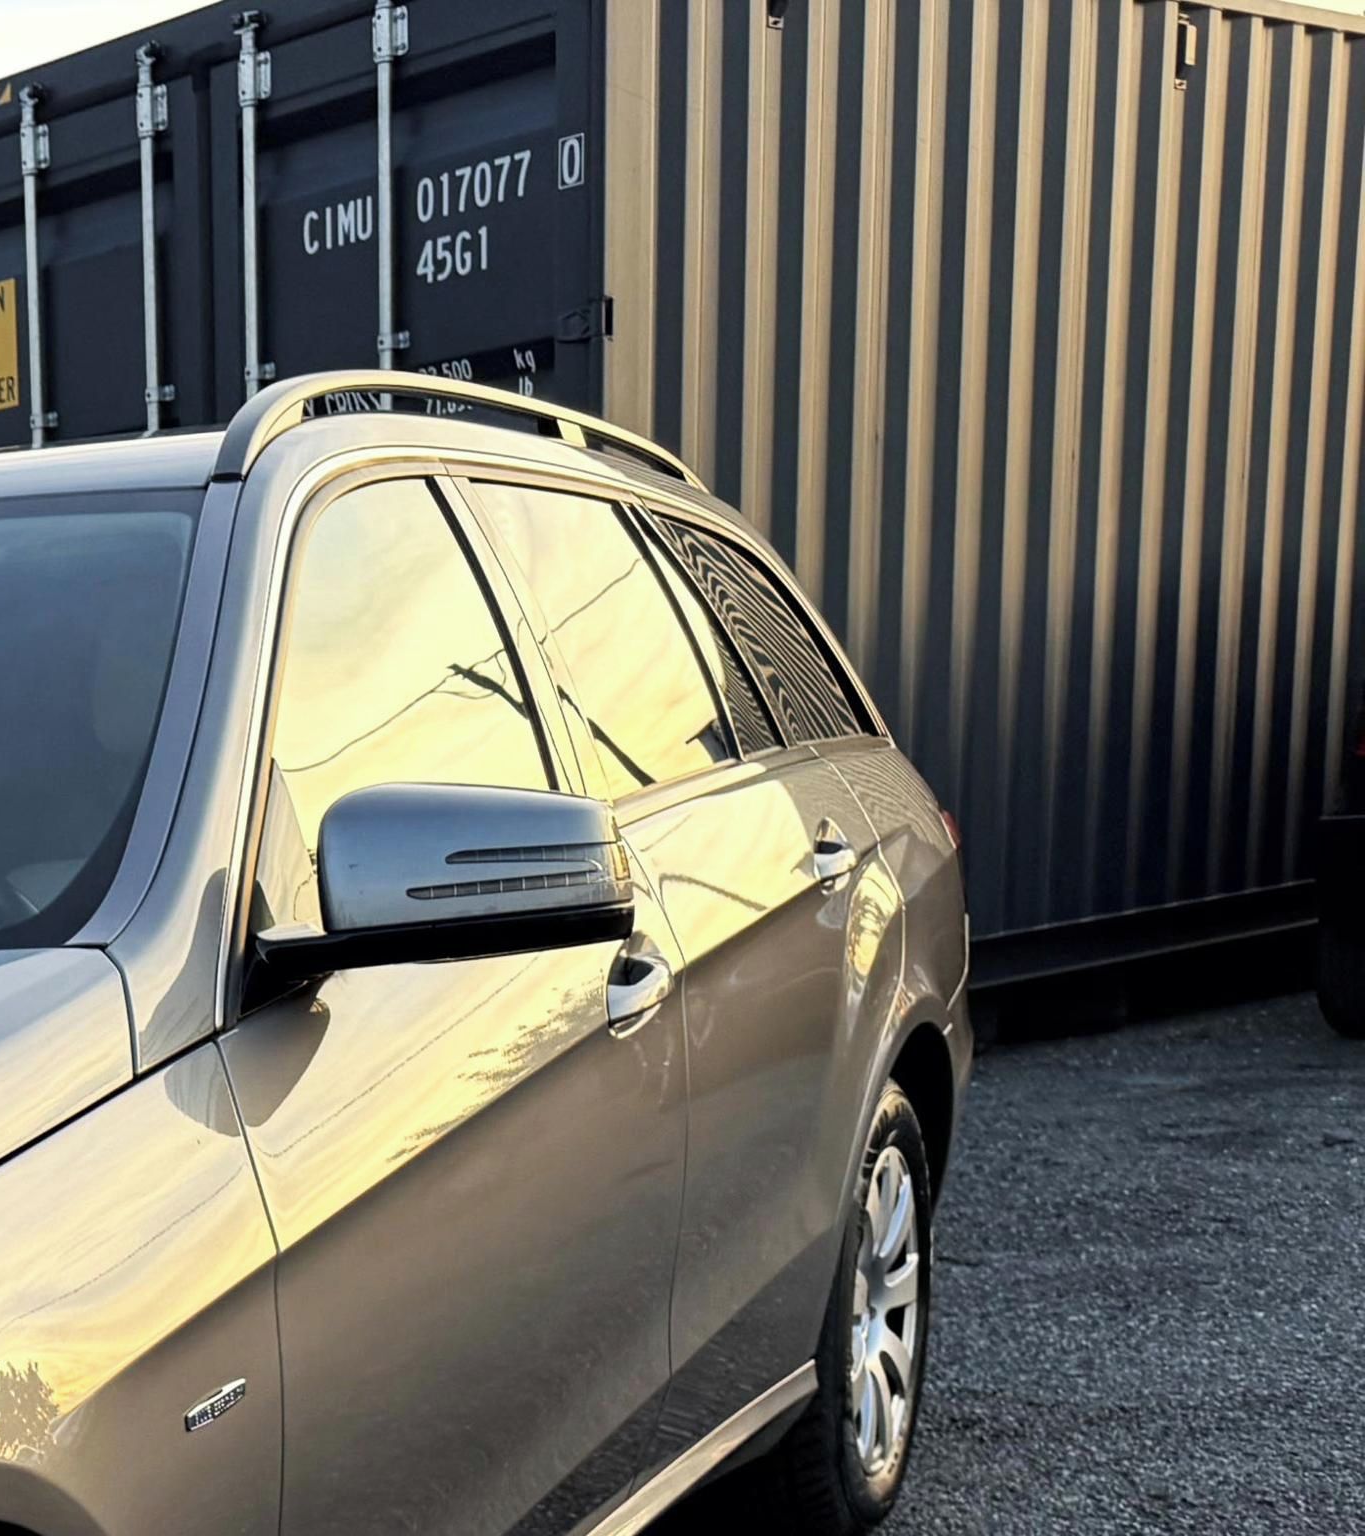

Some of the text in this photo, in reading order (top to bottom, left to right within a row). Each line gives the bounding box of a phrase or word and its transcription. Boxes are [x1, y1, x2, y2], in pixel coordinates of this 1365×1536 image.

[303, 136, 581, 255] CIMU 017077 0
[415, 225, 488, 283] 45G1
[513, 348, 536, 374] kg
[518, 375, 534, 397] lb
